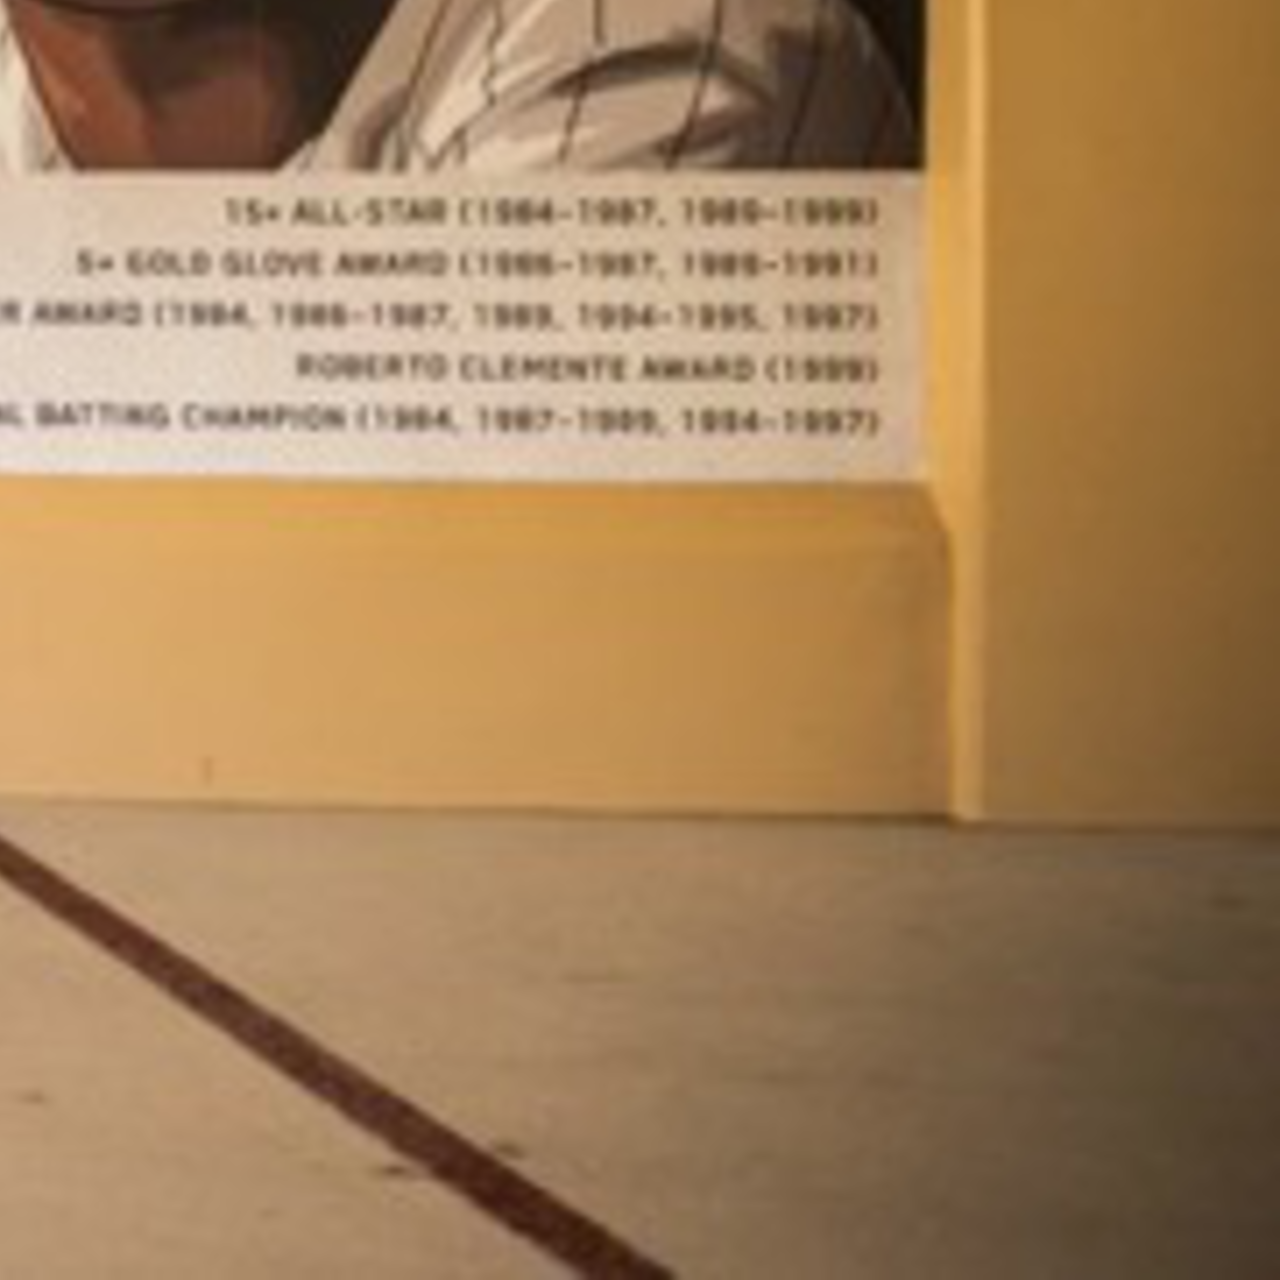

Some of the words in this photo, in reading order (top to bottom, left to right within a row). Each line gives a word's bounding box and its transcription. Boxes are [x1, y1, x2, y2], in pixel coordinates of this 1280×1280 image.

[290, 197, 448, 226] ALL-STAR
[124, 248, 213, 277] GOLD
[220, 249, 323, 277] GLOVE
[333, 250, 450, 277] AWARD
[31, 299, 144, 327] AWARD
[294, 352, 449, 381] ROBERTO
[457, 353, 627, 382] CLEMENTE
[639, 354, 757, 383] AWARD
[33, 400, 172, 430] BATTING
[180, 402, 347, 432] CHAMPION
